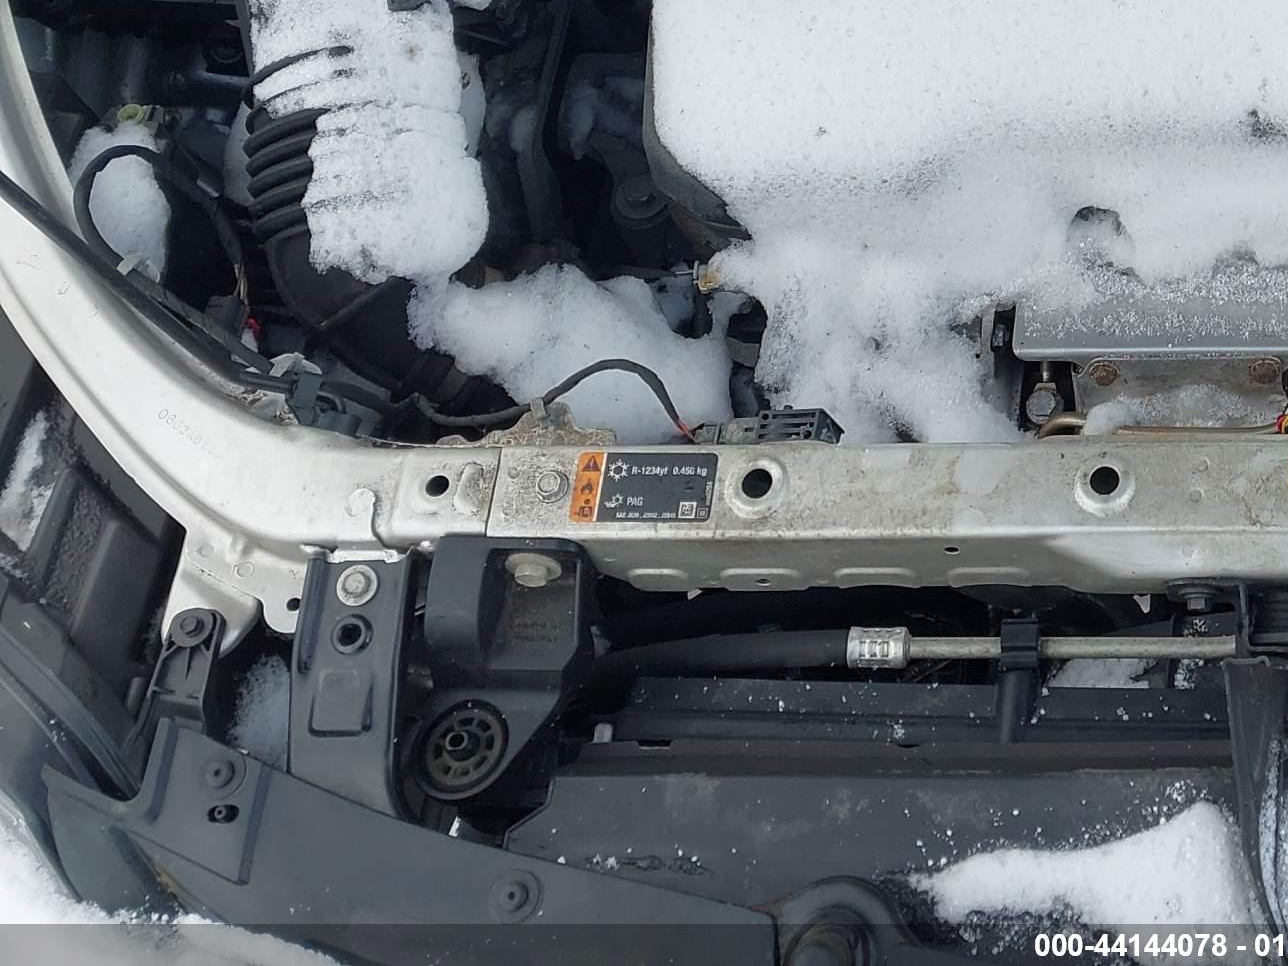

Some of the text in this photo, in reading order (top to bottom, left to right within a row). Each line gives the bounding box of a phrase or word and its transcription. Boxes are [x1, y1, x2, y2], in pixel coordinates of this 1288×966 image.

[631, 465, 707, 477] R-1234yf 0.450 kg
[626, 497, 643, 507] PAG
